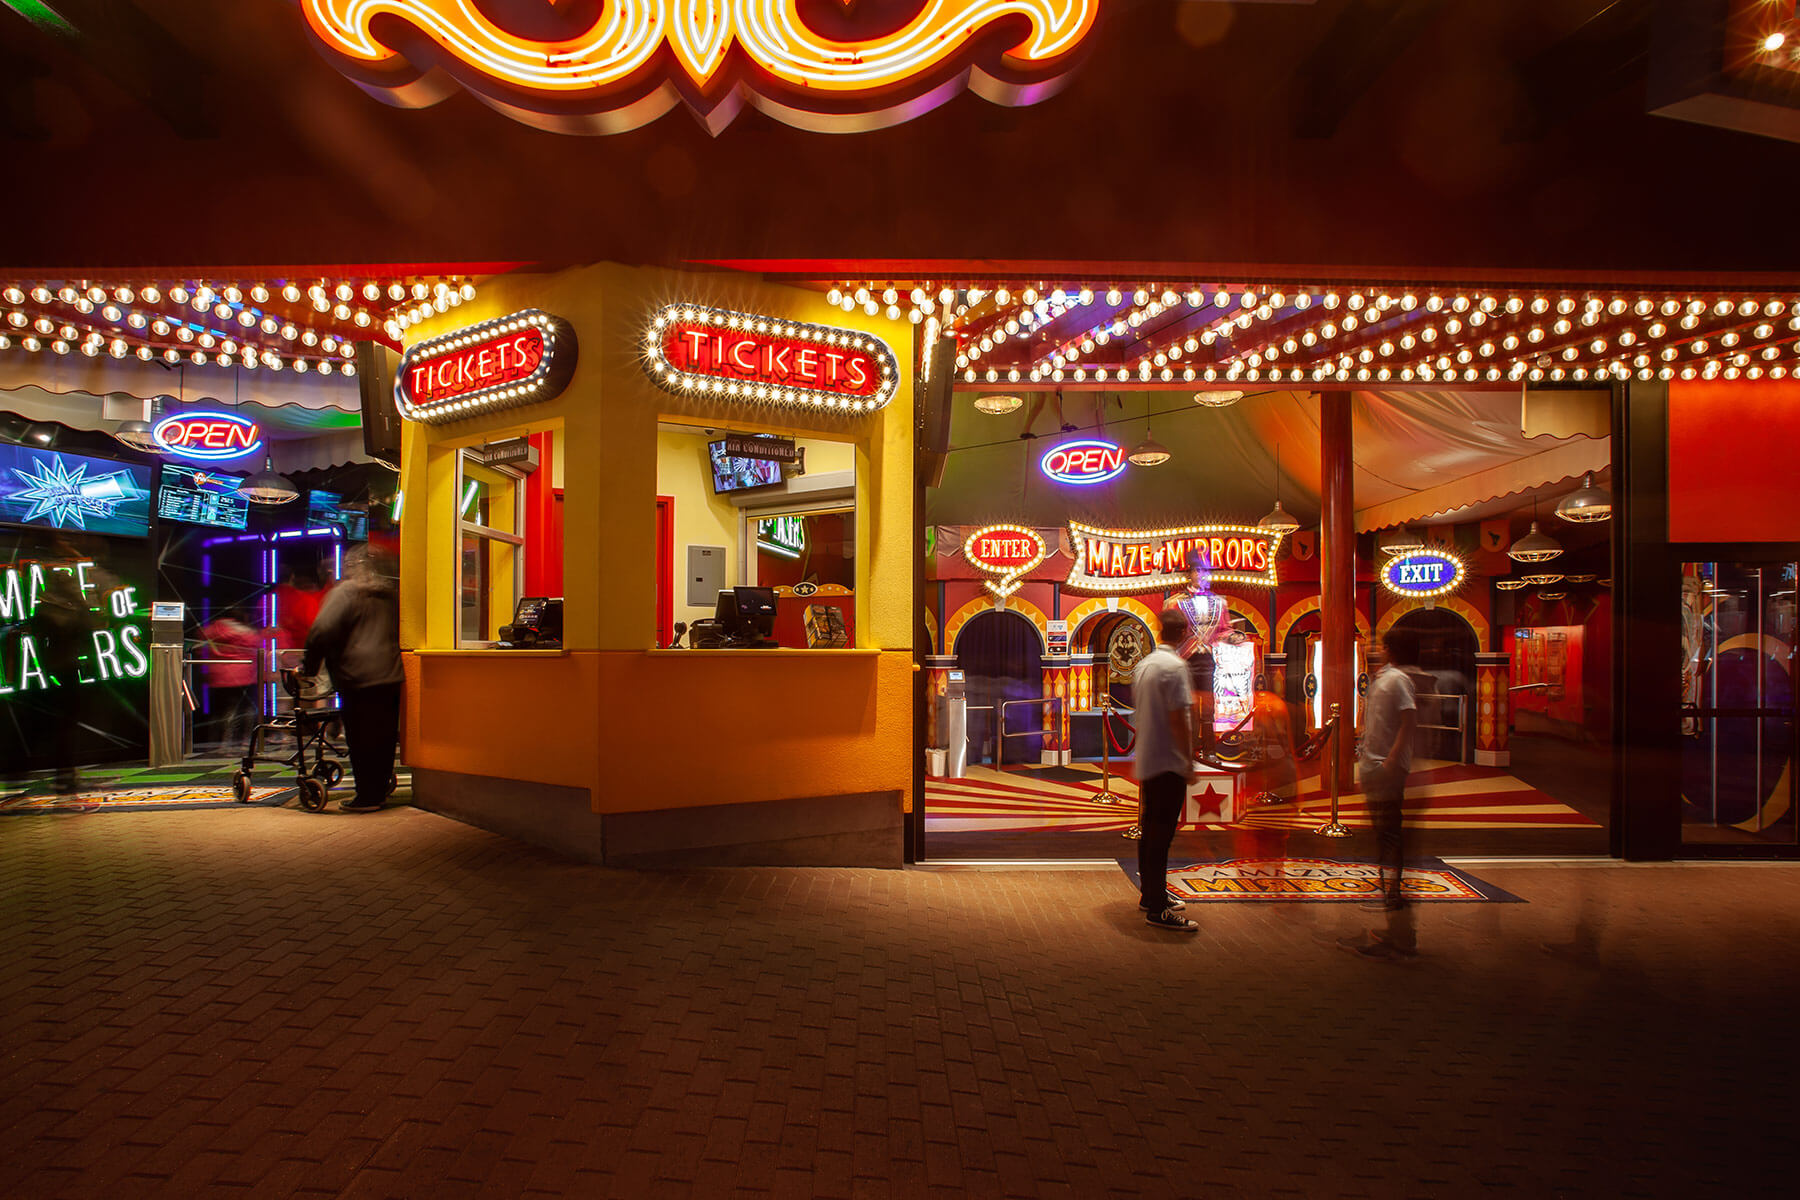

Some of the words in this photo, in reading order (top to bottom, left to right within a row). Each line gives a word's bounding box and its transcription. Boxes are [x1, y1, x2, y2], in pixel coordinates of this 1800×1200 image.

[412, 336, 534, 397] TICKETS
[682, 330, 867, 388] TICKETS
[161, 422, 259, 448] OPEN
[1048, 448, 1123, 474] OPEN
[980, 538, 1032, 559] ENTER
[1086, 539, 1152, 577] MAZE
[1153, 547, 1166, 568] of
[1399, 563, 1443, 584] EXIT
[0, 562, 99, 620] MAE
[111, 586, 138, 618] OF
[1237, 868, 1342, 877] MAZE
